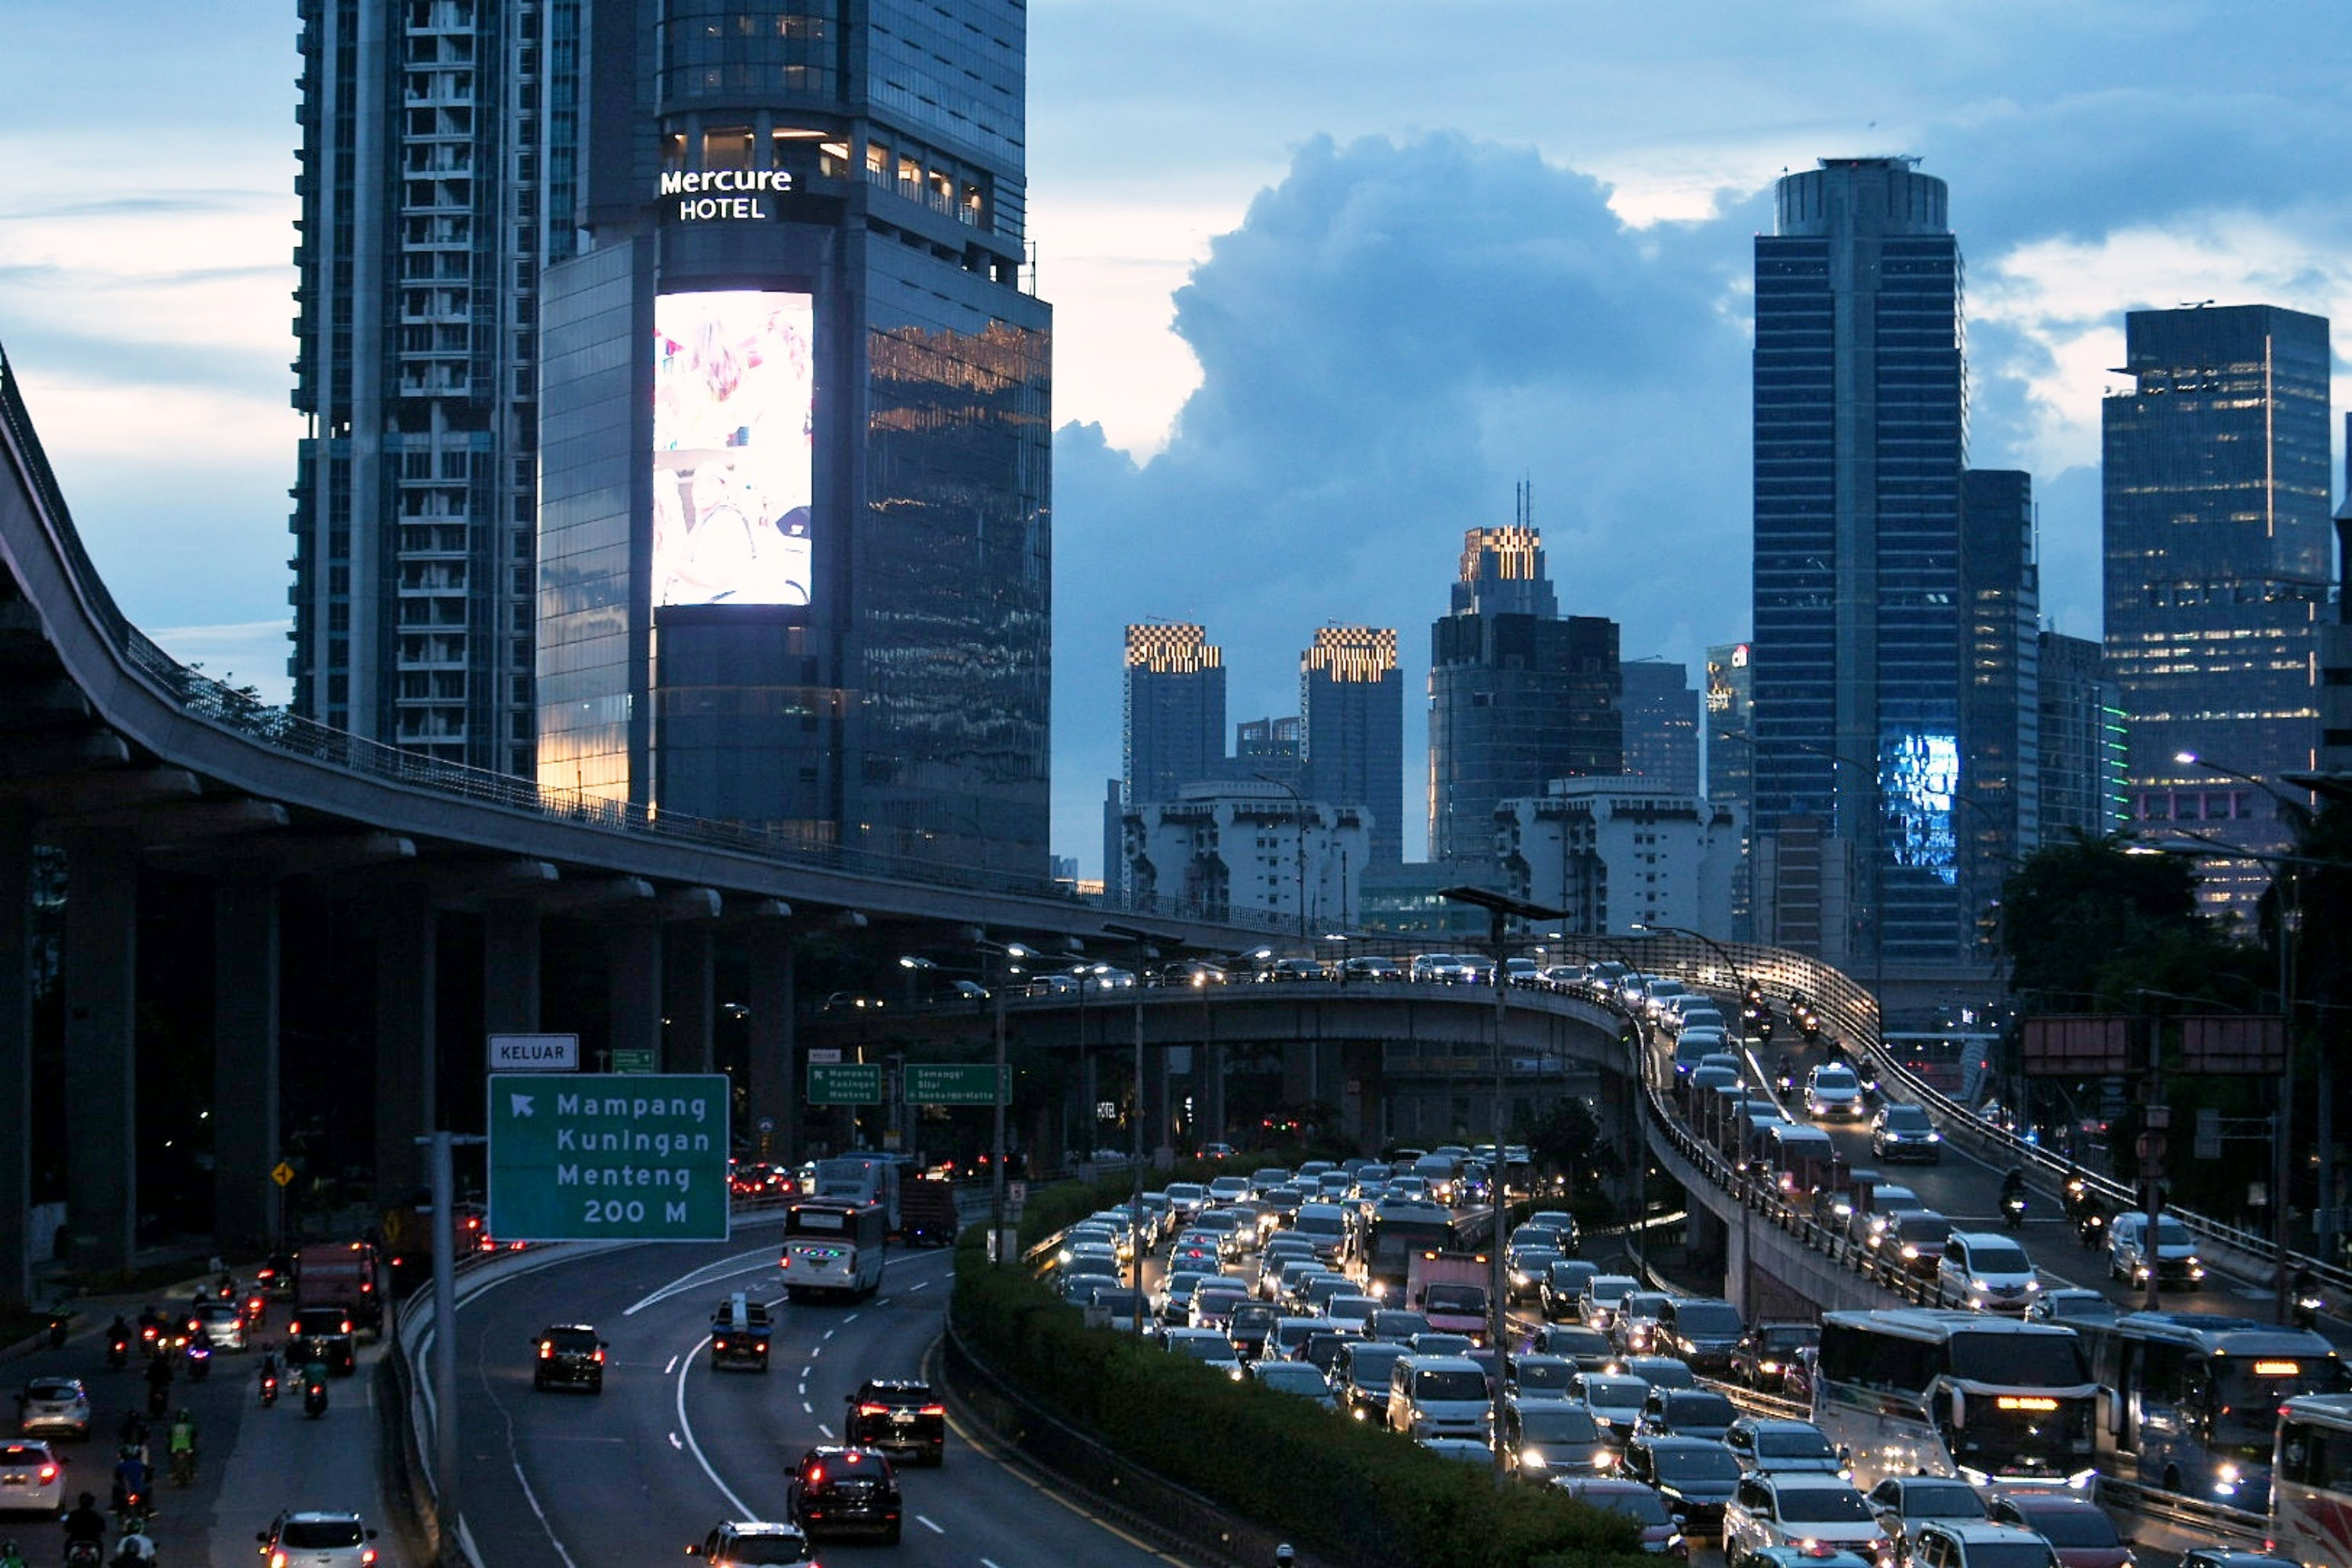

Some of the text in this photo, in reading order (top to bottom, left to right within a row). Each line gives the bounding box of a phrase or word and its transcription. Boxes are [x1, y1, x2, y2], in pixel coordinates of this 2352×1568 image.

[661, 171, 792, 195] Mercure
[680, 198, 766, 220] HOTEL
[500, 1045, 565, 1060] KELUAR
[557, 1094, 706, 1123] Mampang
[1097, 1102, 1116, 1119] HOTEL
[557, 1129, 710, 1157] Kuningan
[557, 1164, 690, 1192] Menteng
[583, 1200, 687, 1223] 200 M
